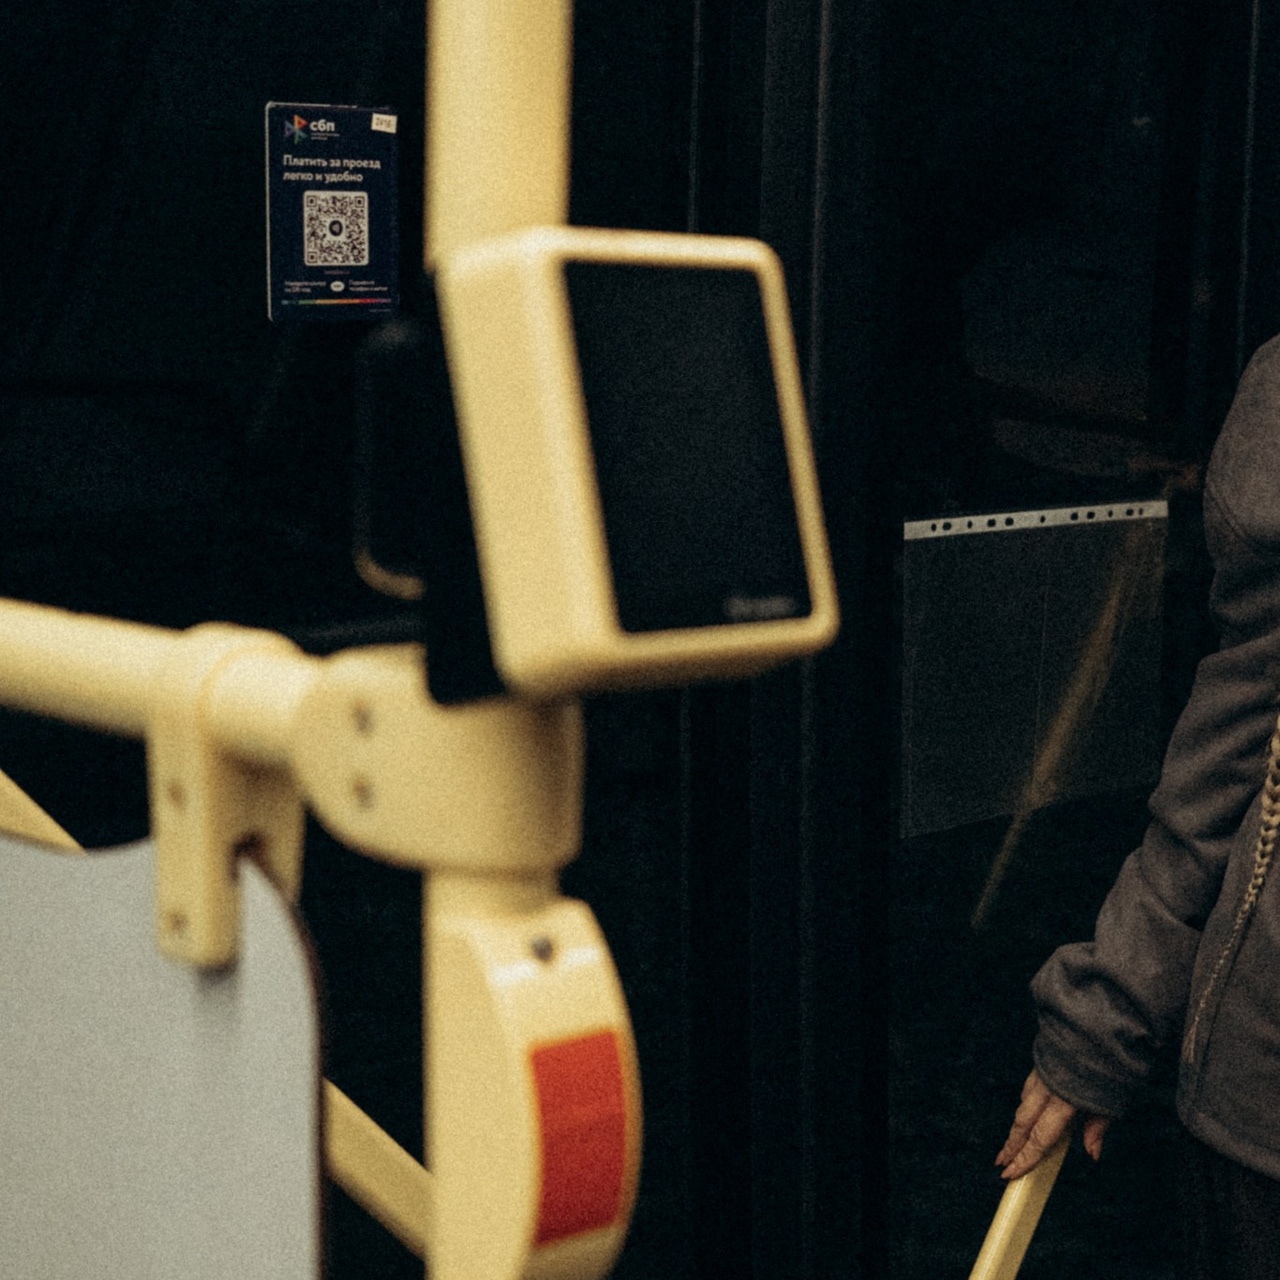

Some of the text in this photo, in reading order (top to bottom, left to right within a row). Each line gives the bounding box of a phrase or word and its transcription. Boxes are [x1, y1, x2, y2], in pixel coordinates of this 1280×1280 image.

[283, 154, 382, 174] Платить за проезд
[282, 171, 364, 185] легко и удобно
